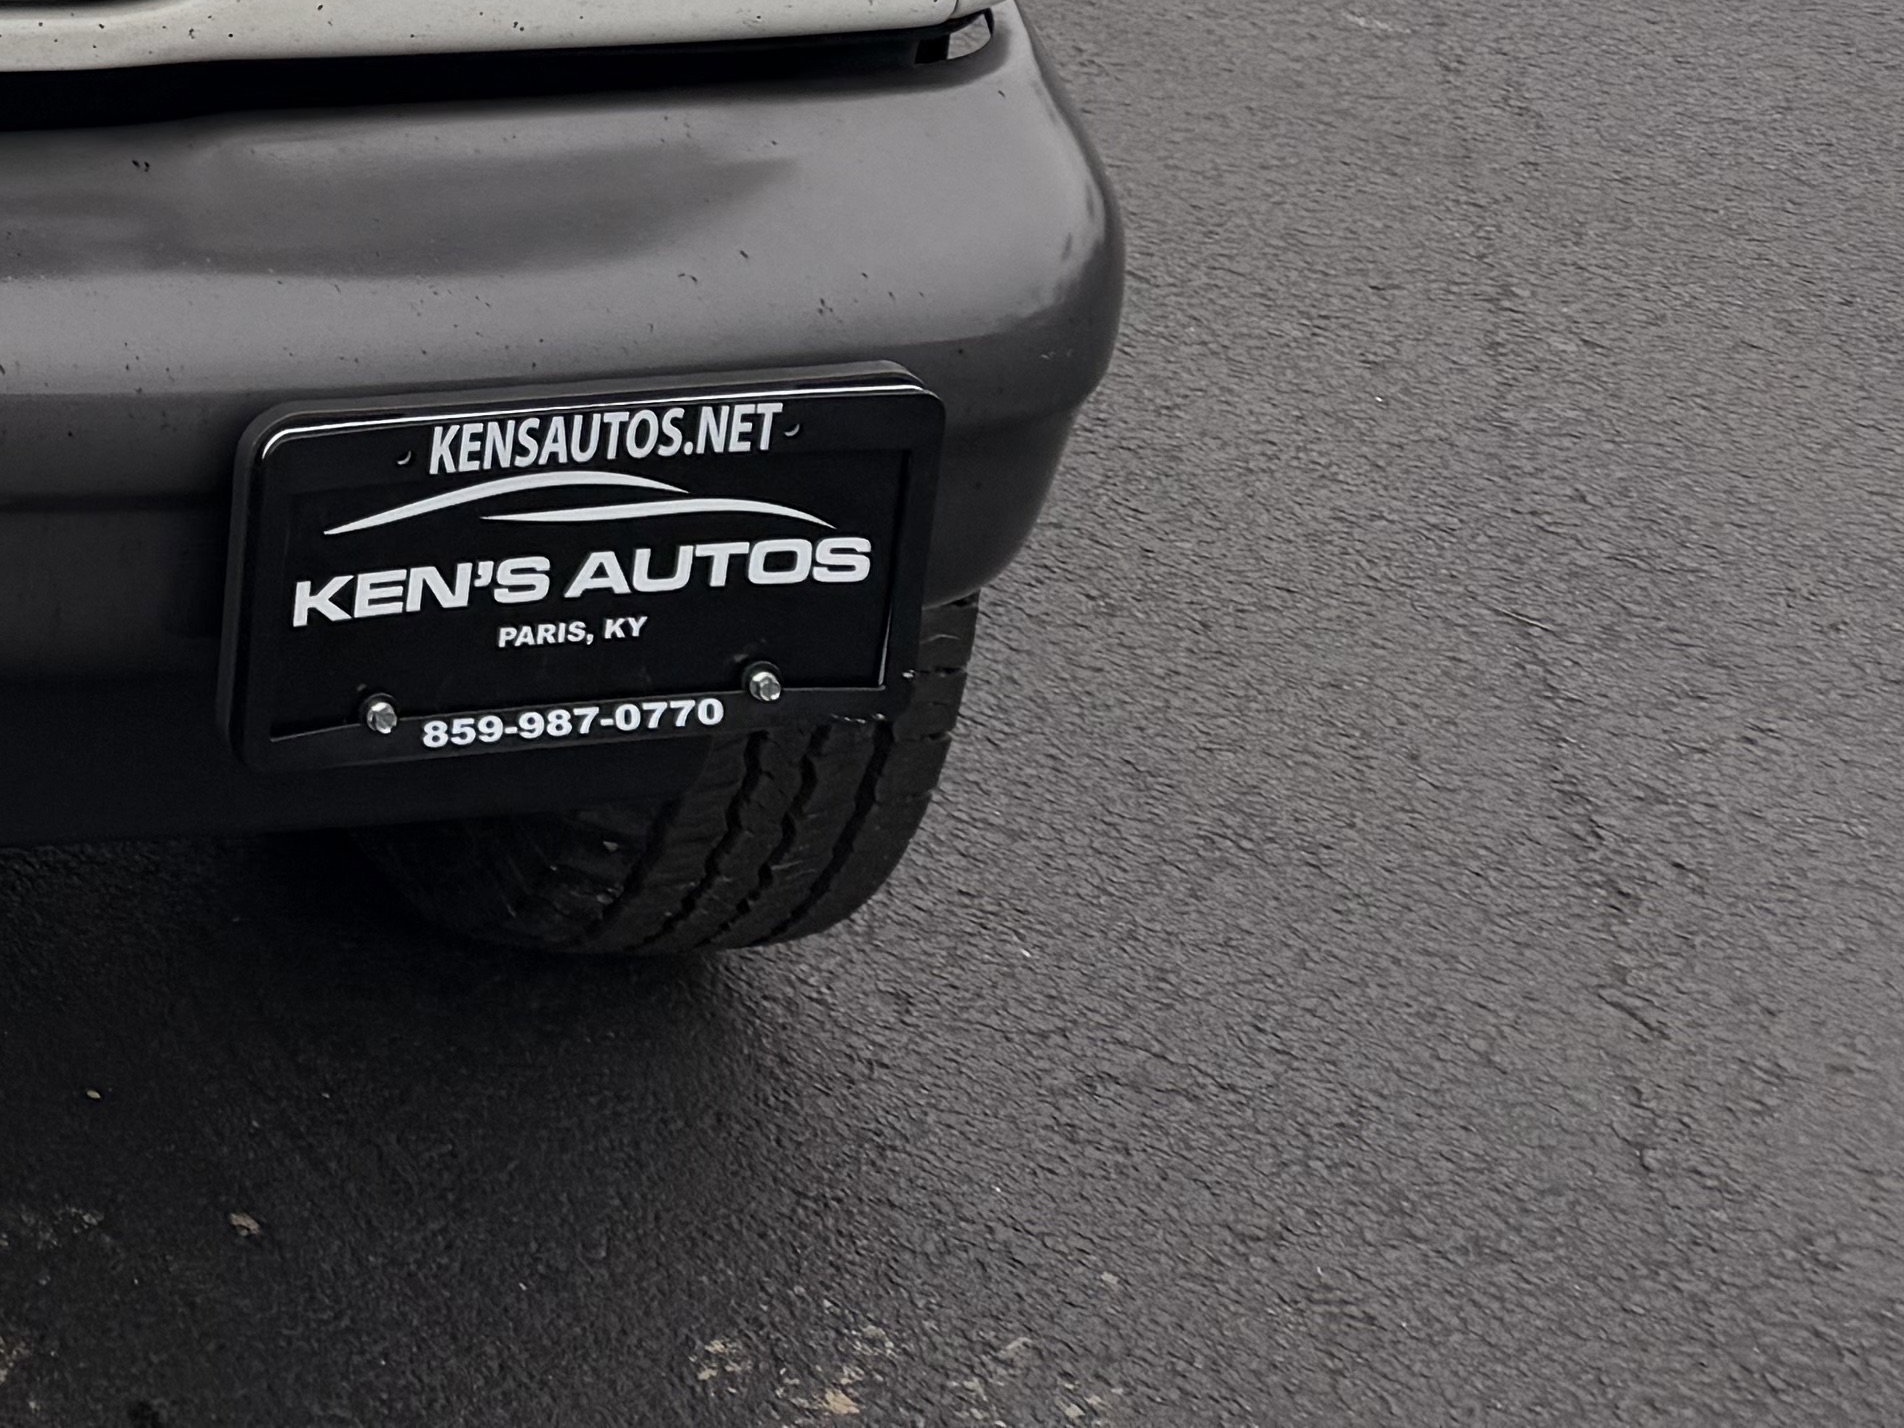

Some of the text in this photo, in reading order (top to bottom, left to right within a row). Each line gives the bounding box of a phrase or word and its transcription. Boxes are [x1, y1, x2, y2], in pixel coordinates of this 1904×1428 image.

[428, 402, 783, 475] KENSAUTOS.NET
[292, 536, 872, 627] KEN'S AUTOS
[497, 615, 648, 648] PARIS, KY
[421, 696, 725, 749] 859-987-0770
